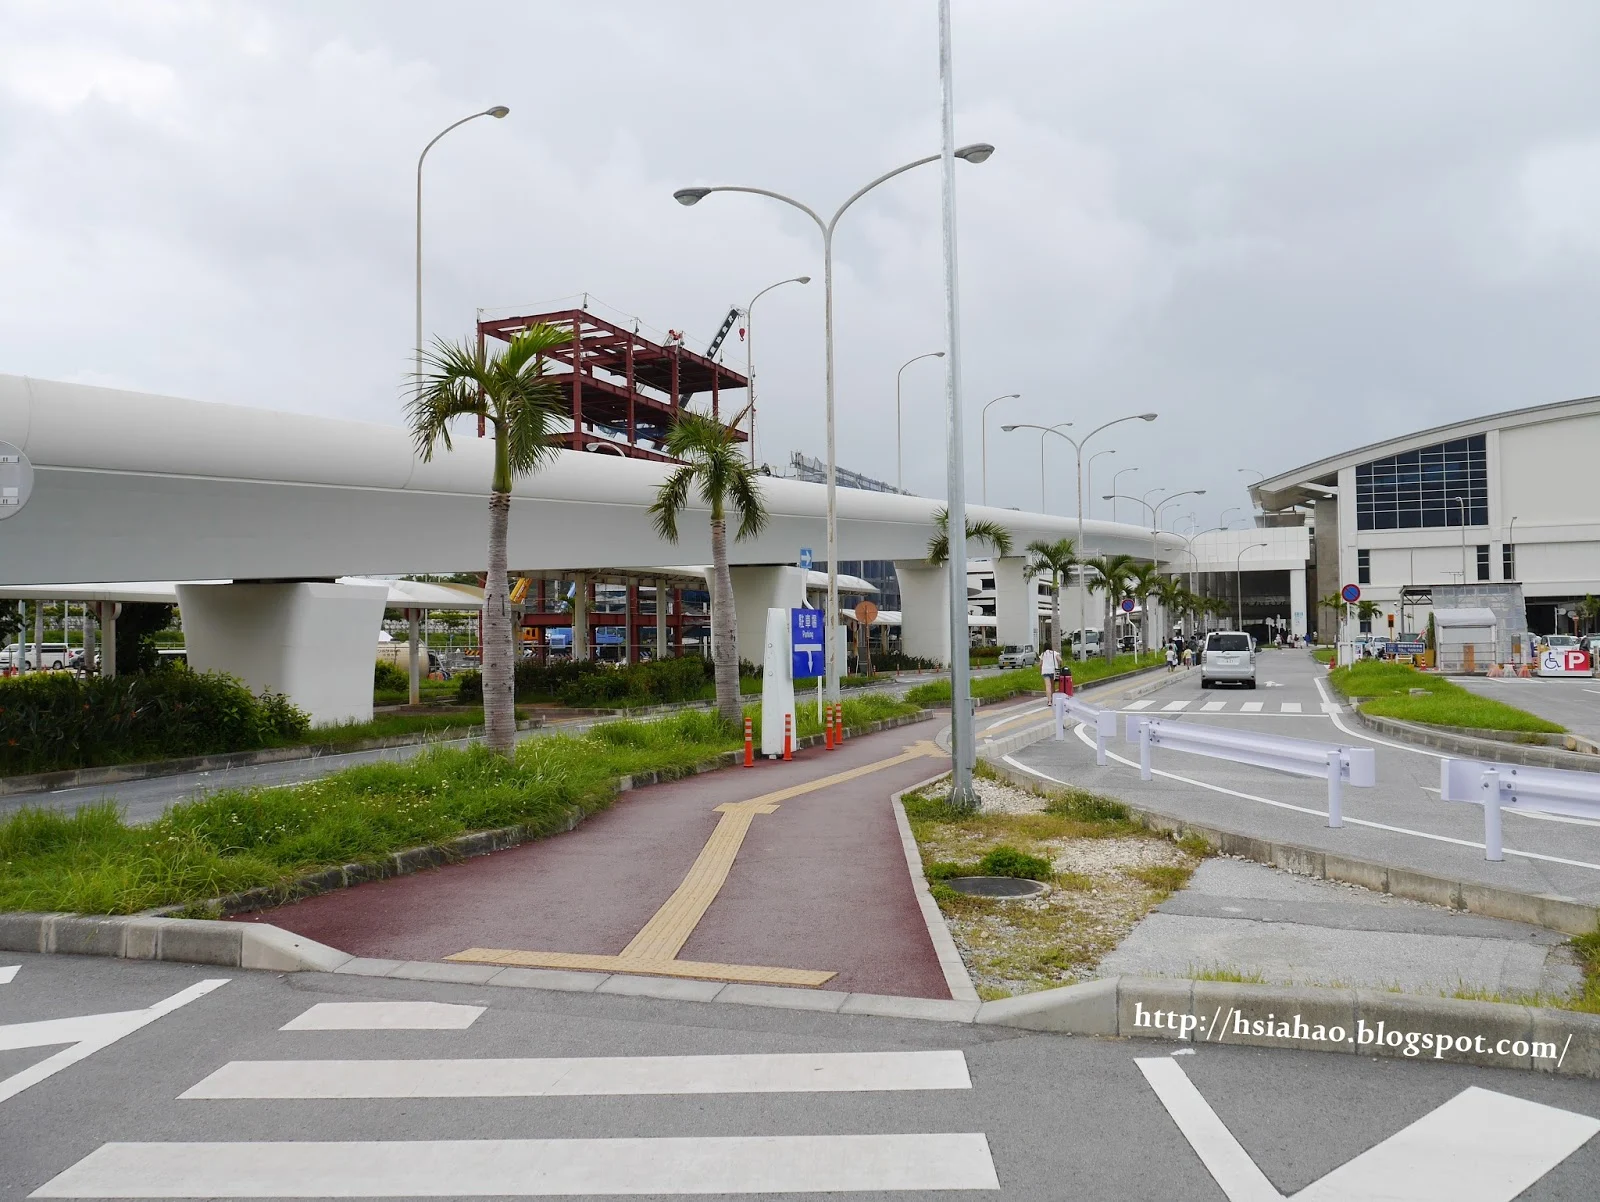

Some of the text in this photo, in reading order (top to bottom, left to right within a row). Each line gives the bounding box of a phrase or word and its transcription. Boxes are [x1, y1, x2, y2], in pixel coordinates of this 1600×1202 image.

[798, 614, 817, 628] 駐車場
[1568, 652, 1585, 669] P
